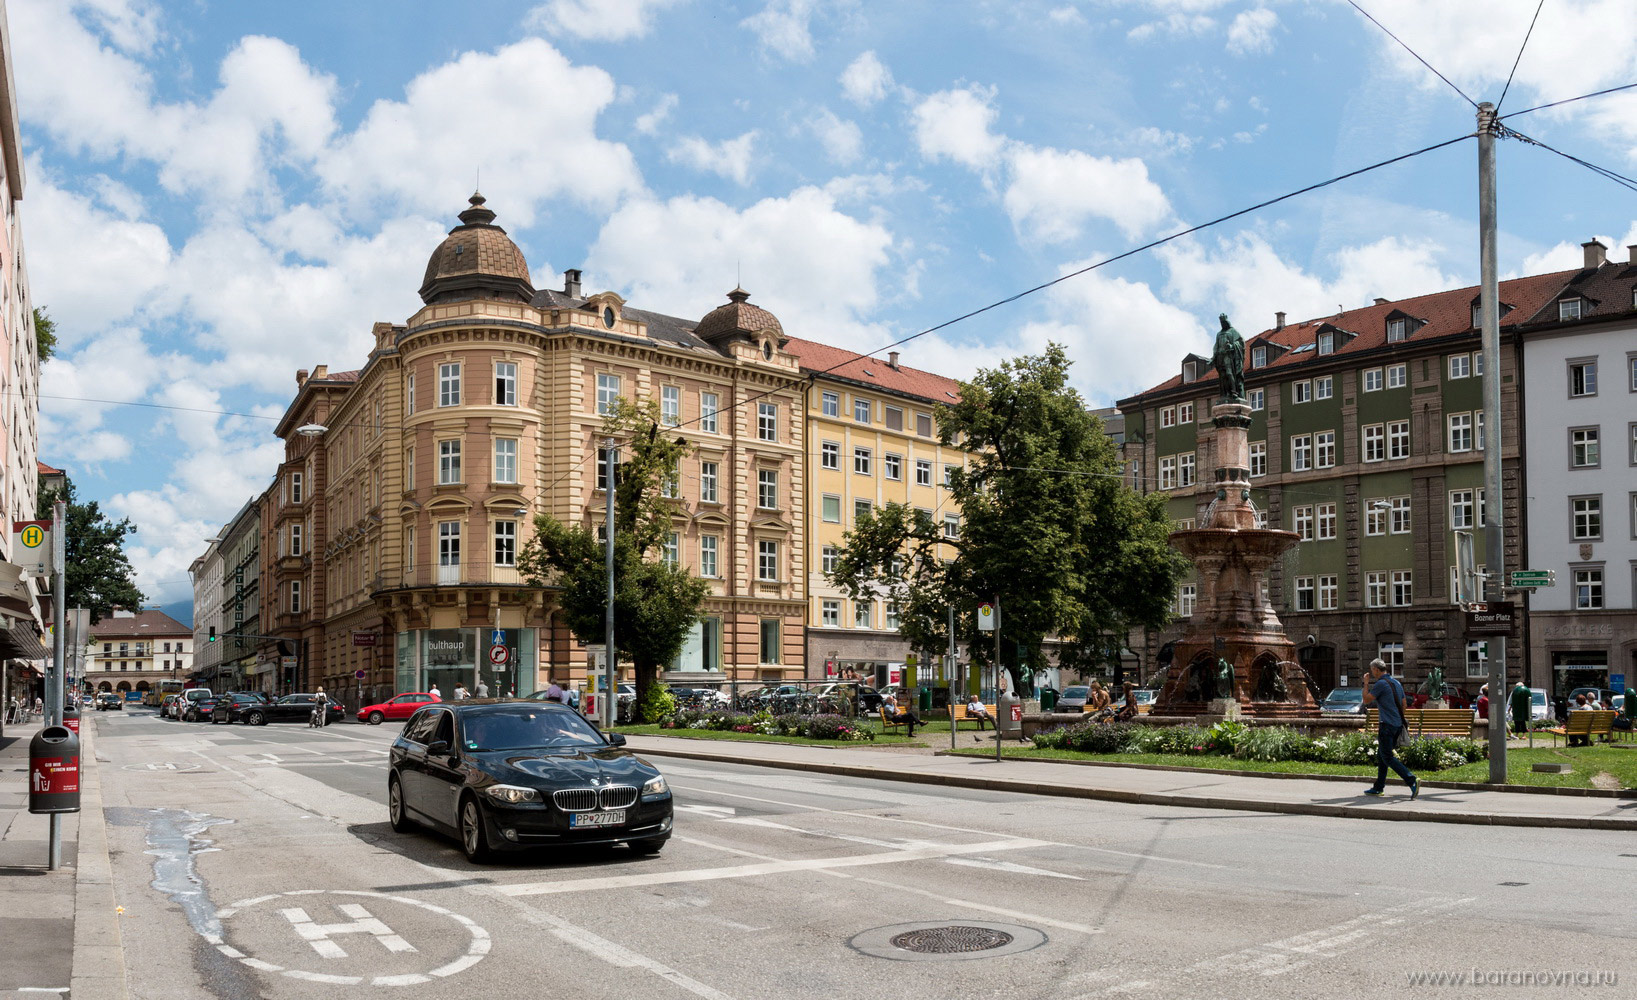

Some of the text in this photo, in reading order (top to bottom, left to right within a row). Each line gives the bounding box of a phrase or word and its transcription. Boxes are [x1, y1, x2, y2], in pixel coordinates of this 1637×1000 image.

[26, 529, 38, 544] H
[1474, 613, 1511, 622] Bozner Platz
[1543, 623, 1613, 636] APOTHEKE
[428, 640, 465, 652] bulthaup
[280, 903, 420, 959] H
